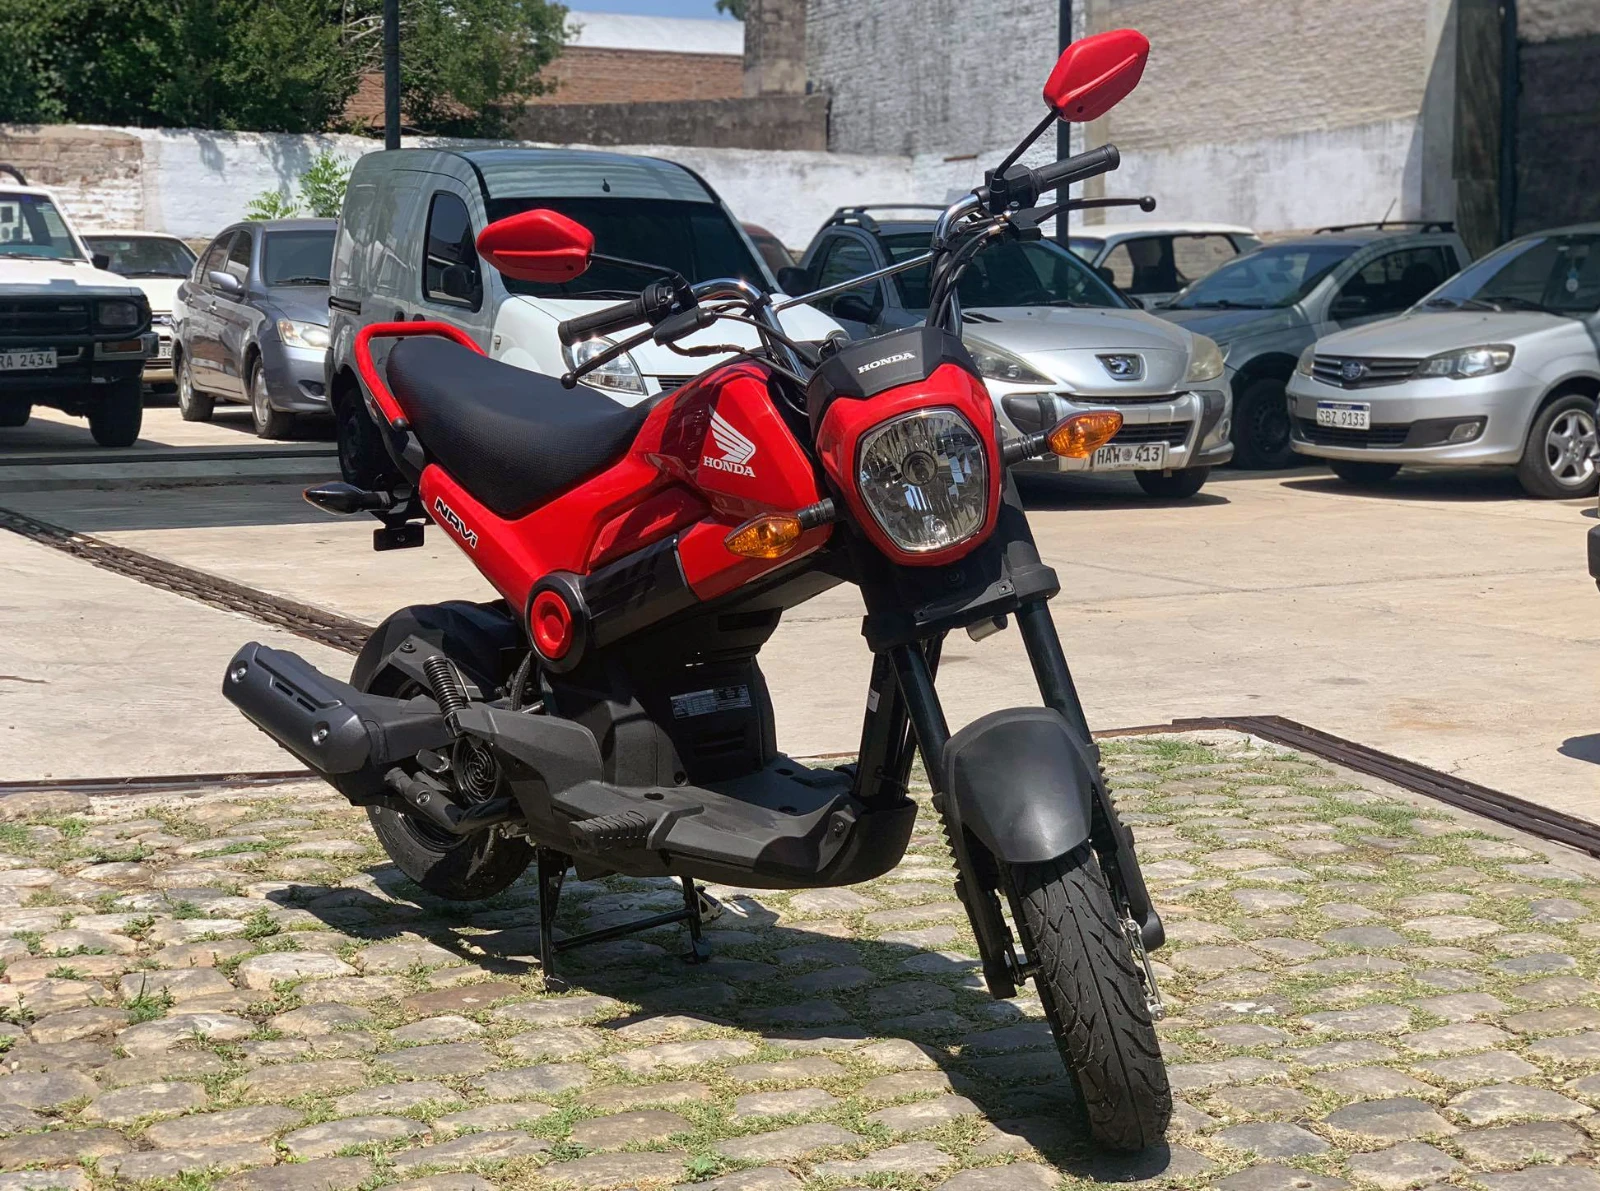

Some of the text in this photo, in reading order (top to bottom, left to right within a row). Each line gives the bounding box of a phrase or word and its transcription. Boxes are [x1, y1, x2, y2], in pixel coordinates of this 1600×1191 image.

[20, 353, 53, 367] 2434
[857, 352, 915, 374] HONDA
[1319, 410, 1365, 426] SBZ 9133
[1097, 445, 1160, 464] HAW 413
[703, 455, 756, 478] HONDA
